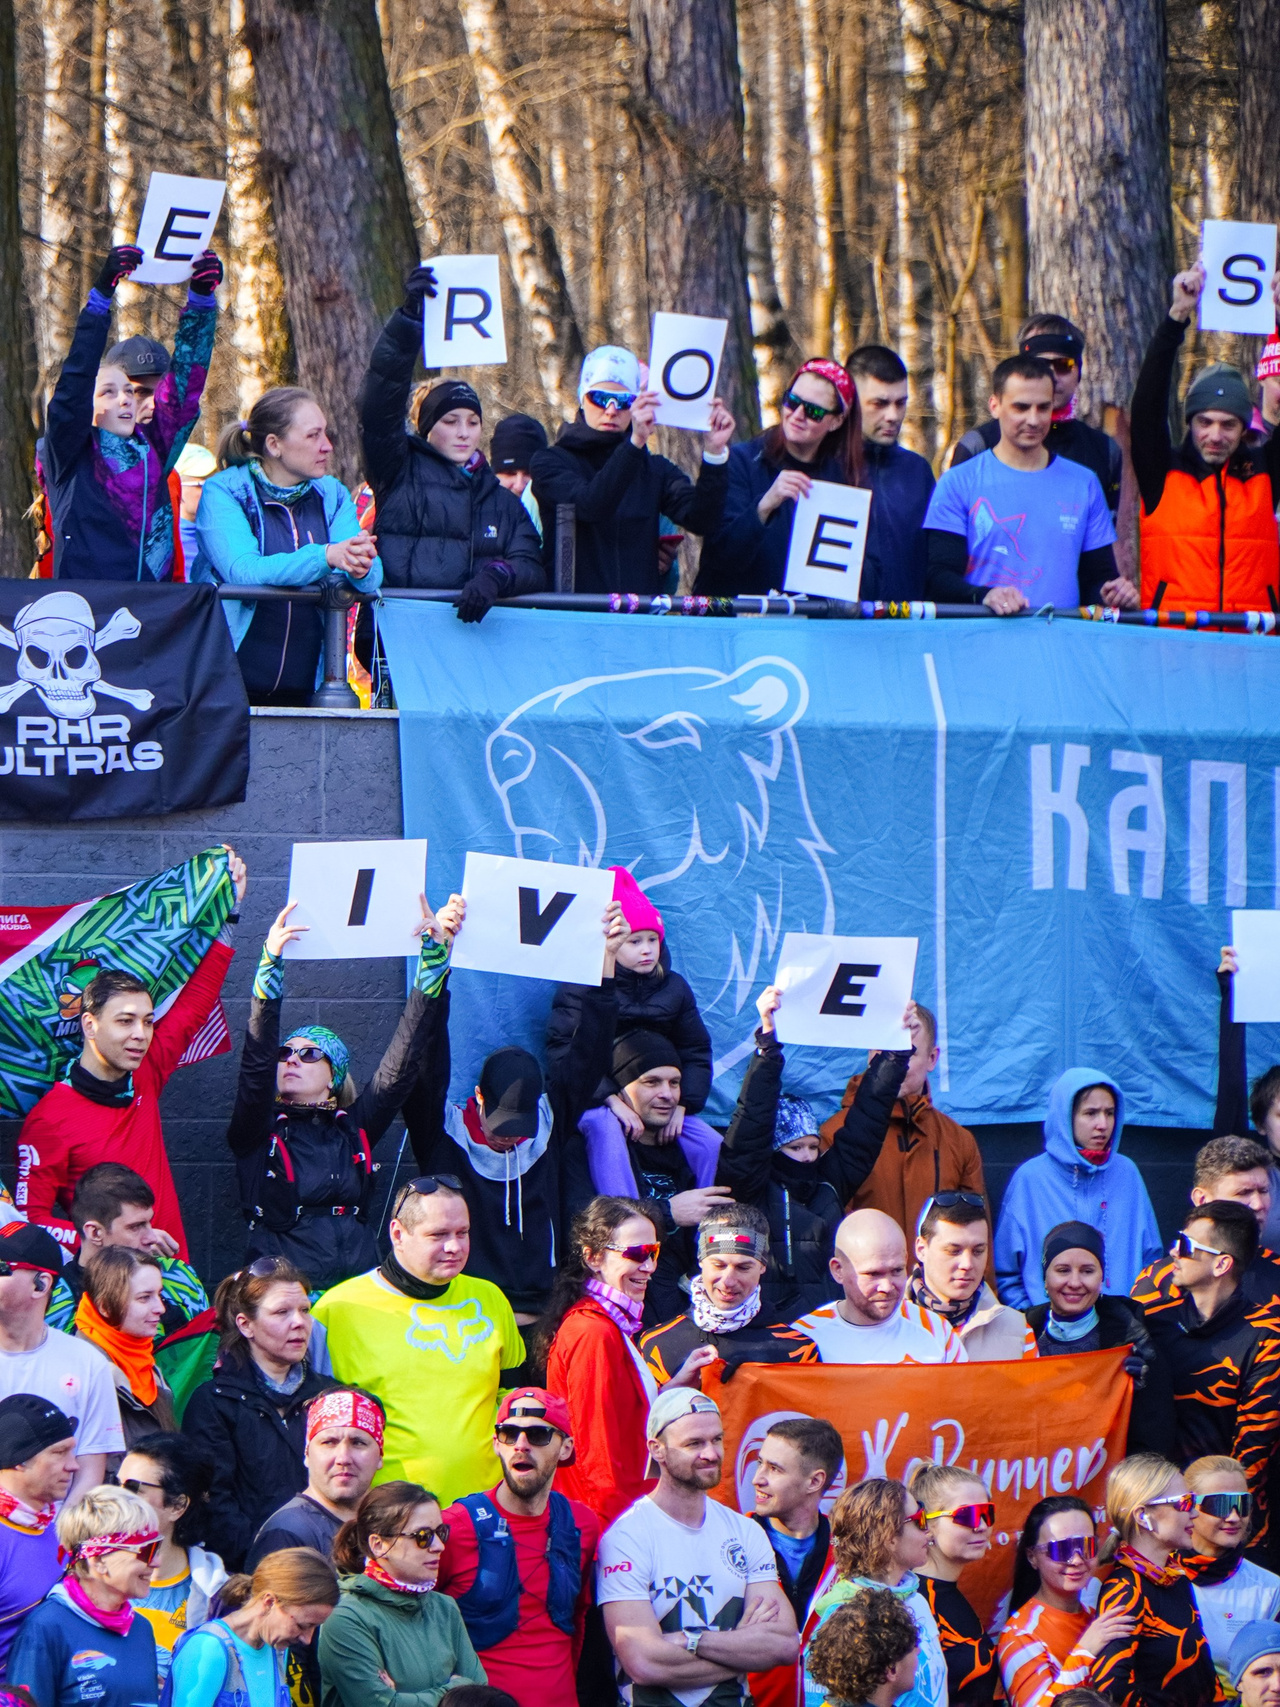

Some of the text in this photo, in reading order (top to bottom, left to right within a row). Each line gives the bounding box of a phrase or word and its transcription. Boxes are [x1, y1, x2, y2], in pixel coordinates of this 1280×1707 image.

[154, 206, 211, 261] E
[1218, 254, 1266, 306] S
[444, 287, 491, 340] R
[663, 349, 715, 402] O
[805, 514, 859, 573] E
[17, 714, 131, 745] RHR
[1030, 742, 1280, 908] КАП
[347, 868, 375, 927] I
[516, 886, 577, 947] V
[819, 963, 881, 1017] E
